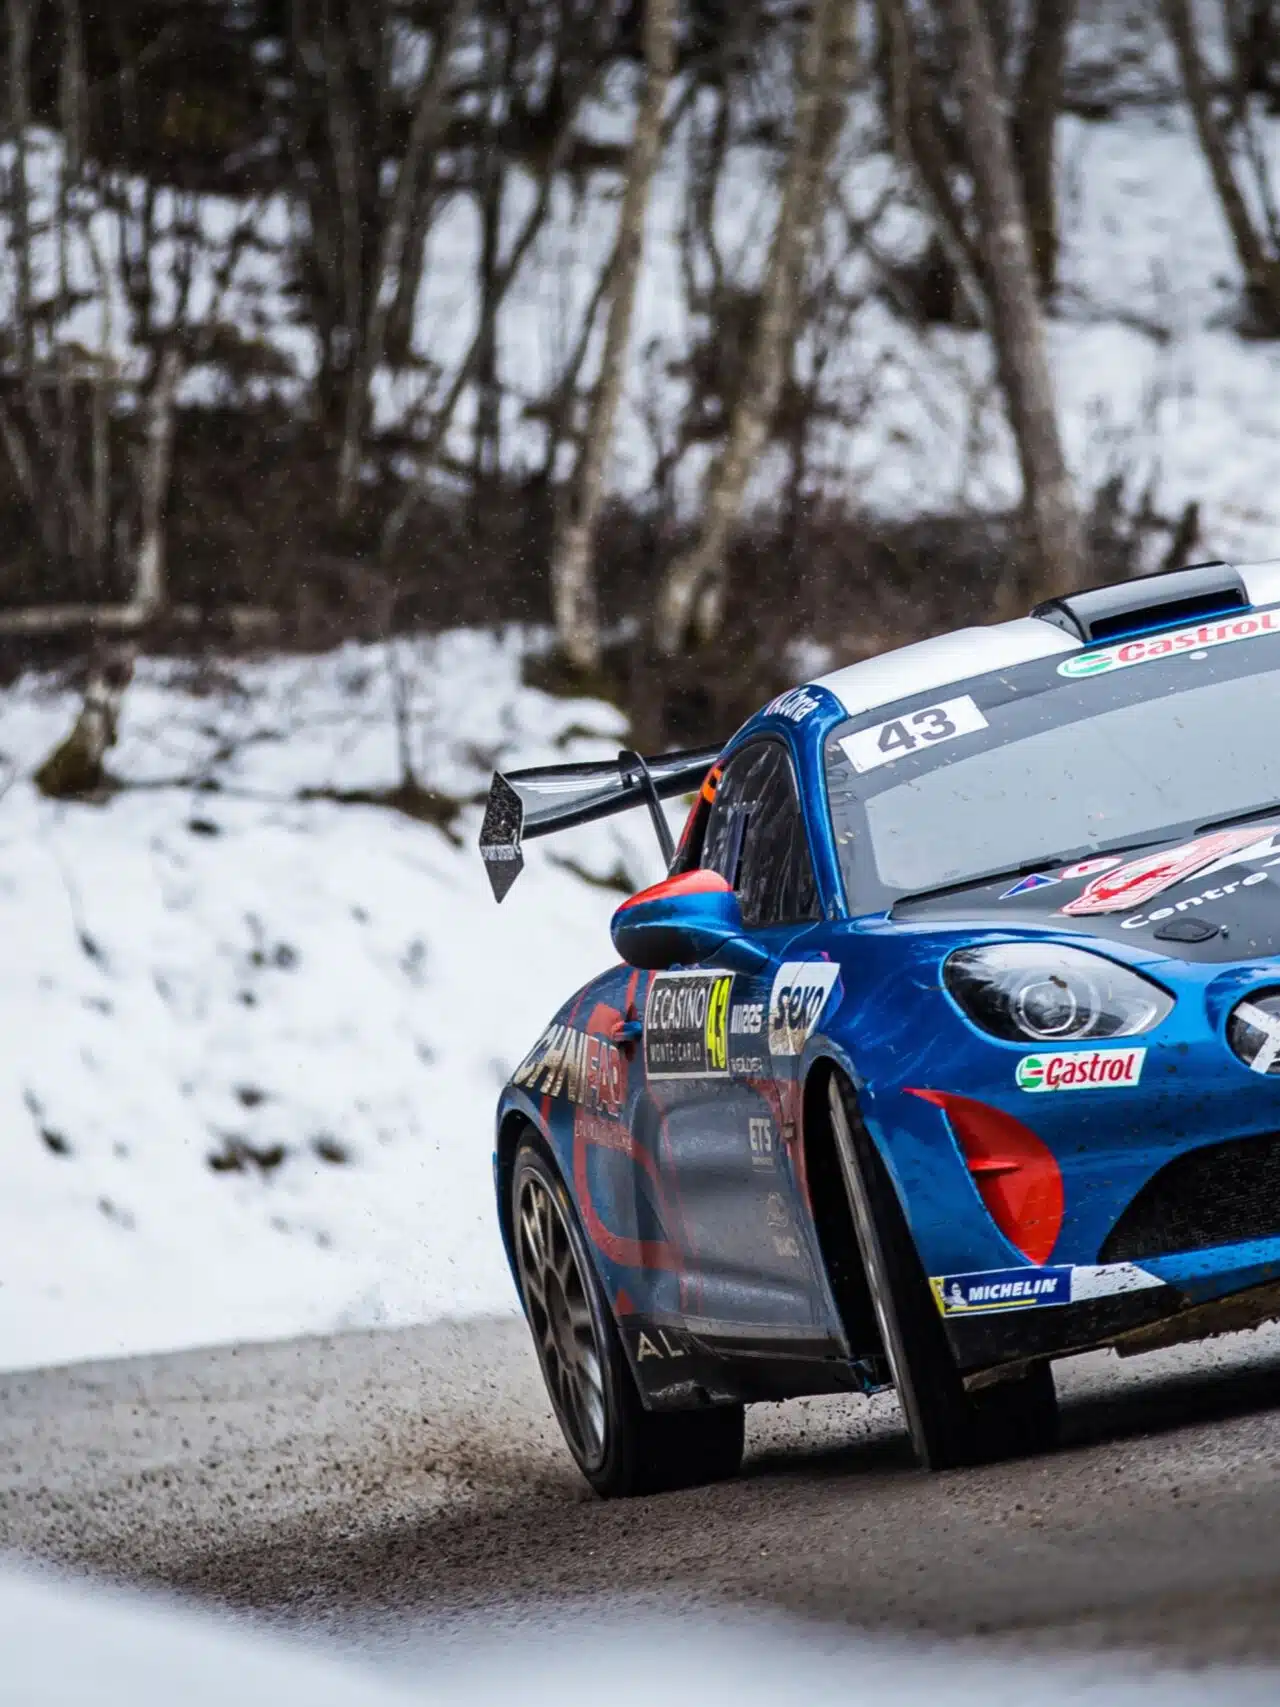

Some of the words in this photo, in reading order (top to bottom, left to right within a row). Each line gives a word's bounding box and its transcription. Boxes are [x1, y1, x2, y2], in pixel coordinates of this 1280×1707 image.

[1116, 614, 1279, 664] Castrol
[876, 708, 957, 754] 43
[1120, 871, 1269, 930] Centre
[707, 977, 730, 1069] 43
[1046, 1054, 1135, 1087] Castrol
[968, 1278, 1058, 1301] MICHELIN
